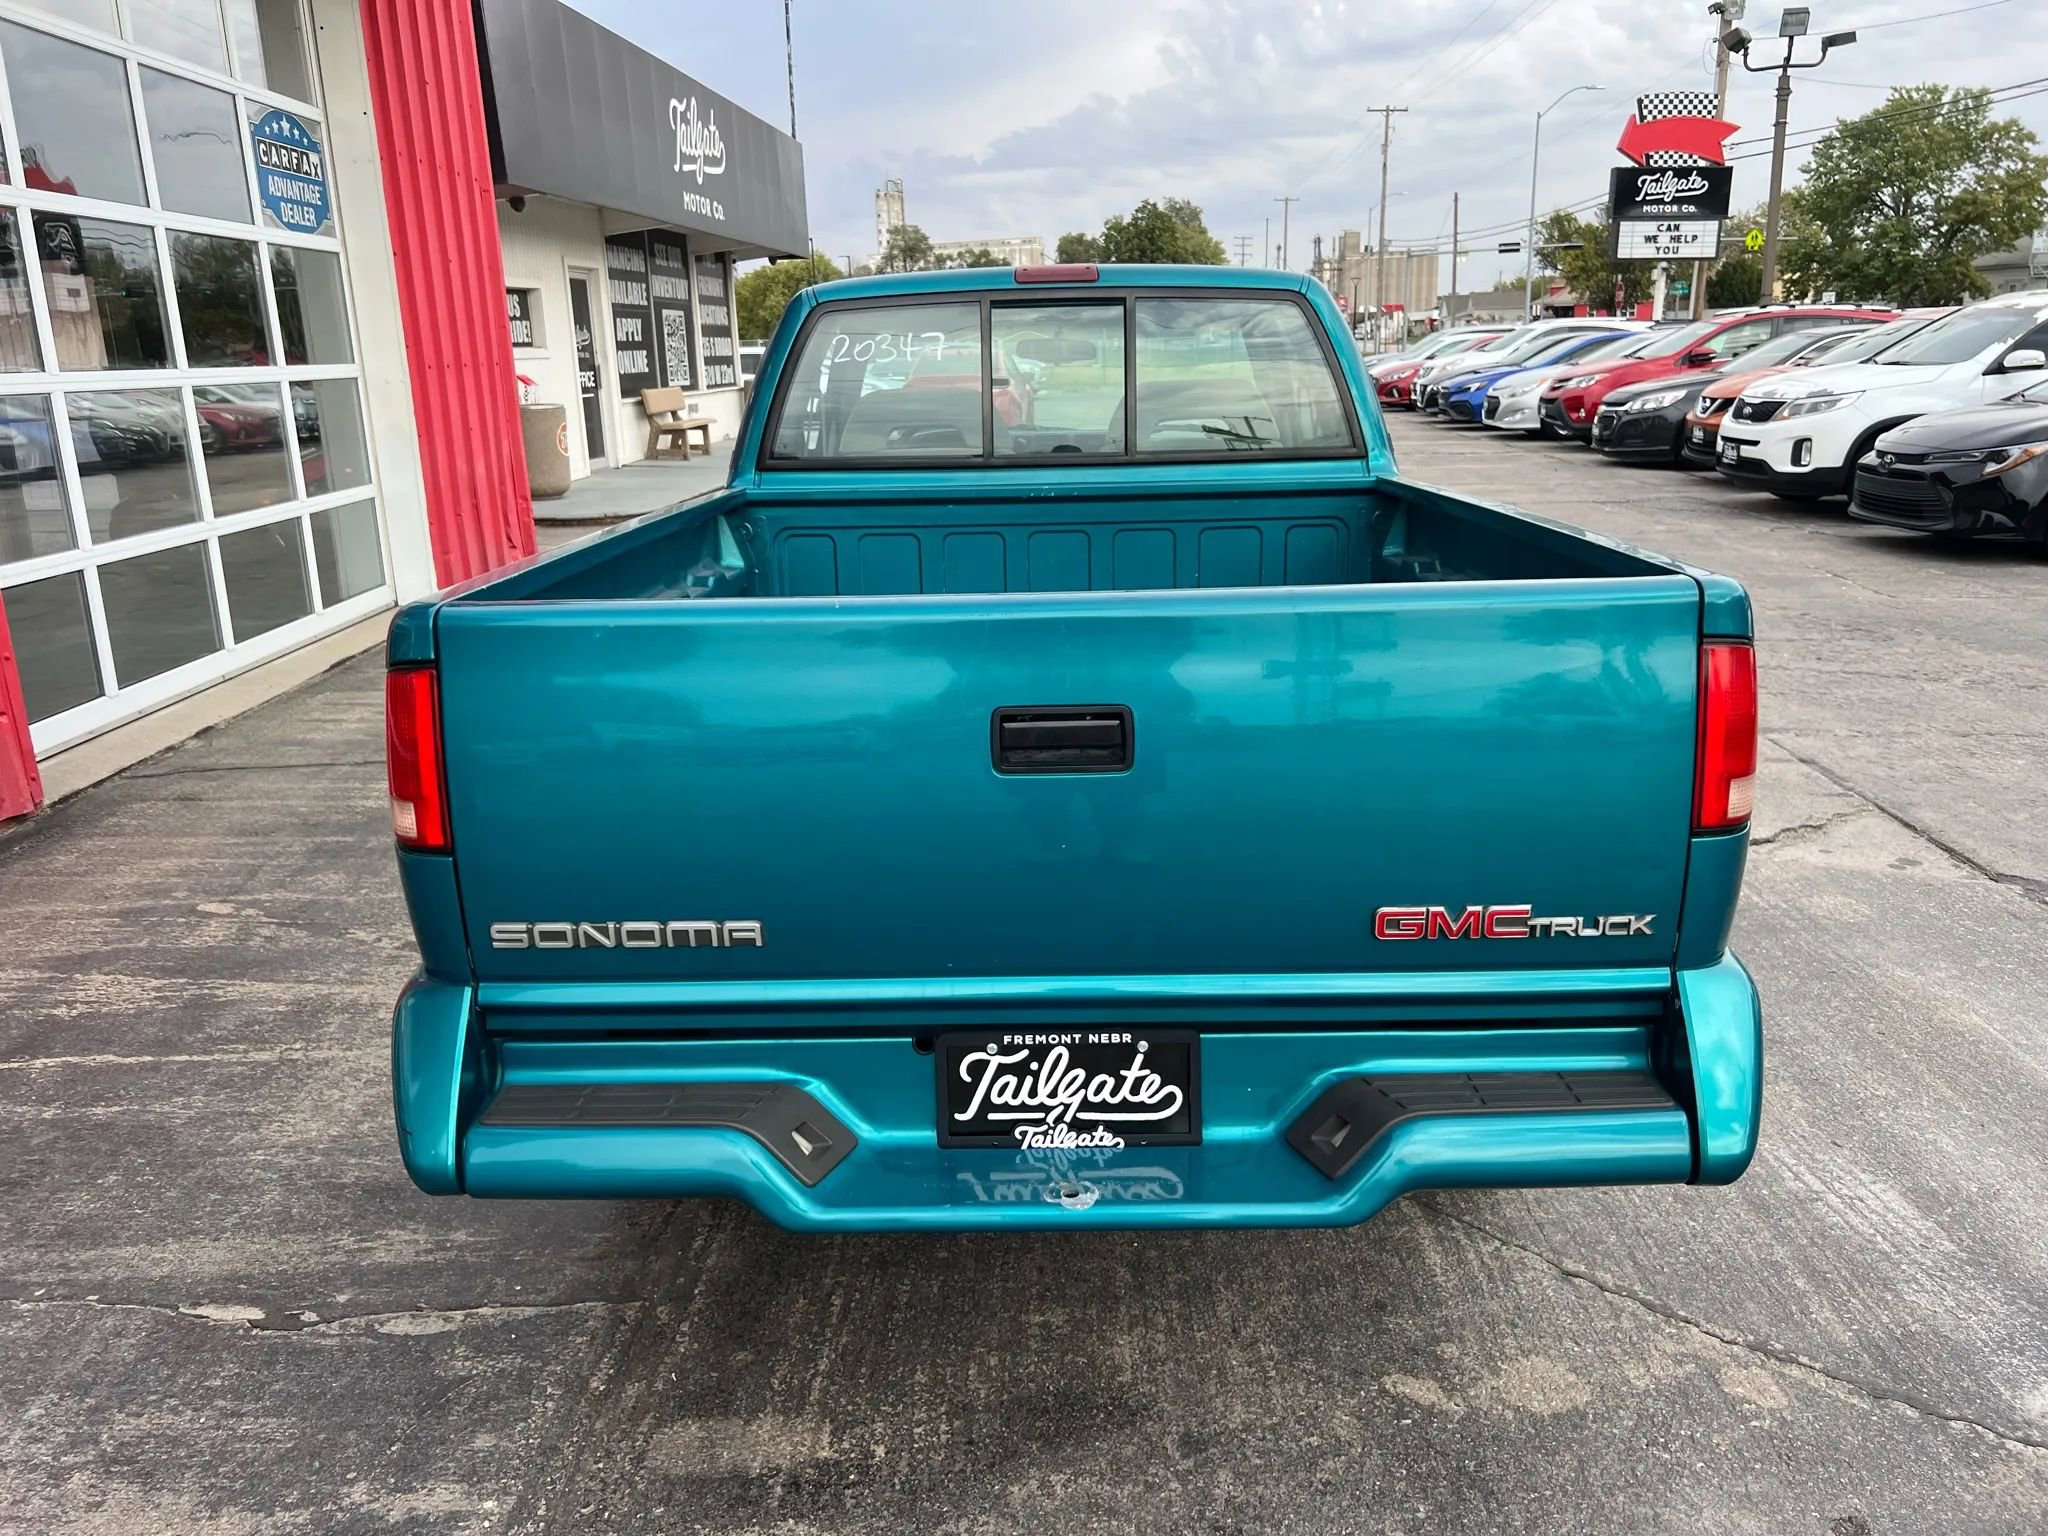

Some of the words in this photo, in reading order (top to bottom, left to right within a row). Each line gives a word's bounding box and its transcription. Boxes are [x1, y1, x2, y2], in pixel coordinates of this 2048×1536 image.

[669, 96, 726, 185] Tailgate
[259, 142, 322, 180] CARFAX
[268, 174, 322, 206] ADVANTAGE
[1635, 170, 1709, 202] Tailgate
[280, 202, 317, 228] DEALER
[683, 191, 712, 217] MOTOR
[713, 200, 726, 221] CO.
[1642, 204, 1678, 213] MOTOR
[1681, 204, 1698, 213] CO.
[1644, 234, 1660, 244] WE
[1669, 234, 1698, 244] HELP
[1657, 223, 1680, 232] CAN
[1655, 246, 1680, 255] YOU
[616, 317, 642, 341] APPLY
[832, 331, 947, 362] 20347
[617, 350, 649, 375] ONLINE
[490, 920, 763, 949] SONOMA
[1375, 903, 1533, 940] GMC
[1528, 913, 1657, 937] TRUCK
[1003, 1034, 1082, 1046] FREMONT
[1088, 1033, 1132, 1044] NEBR
[954, 1045, 1184, 1126] Tailgate
[1014, 1122, 1126, 1150] Tailgate
